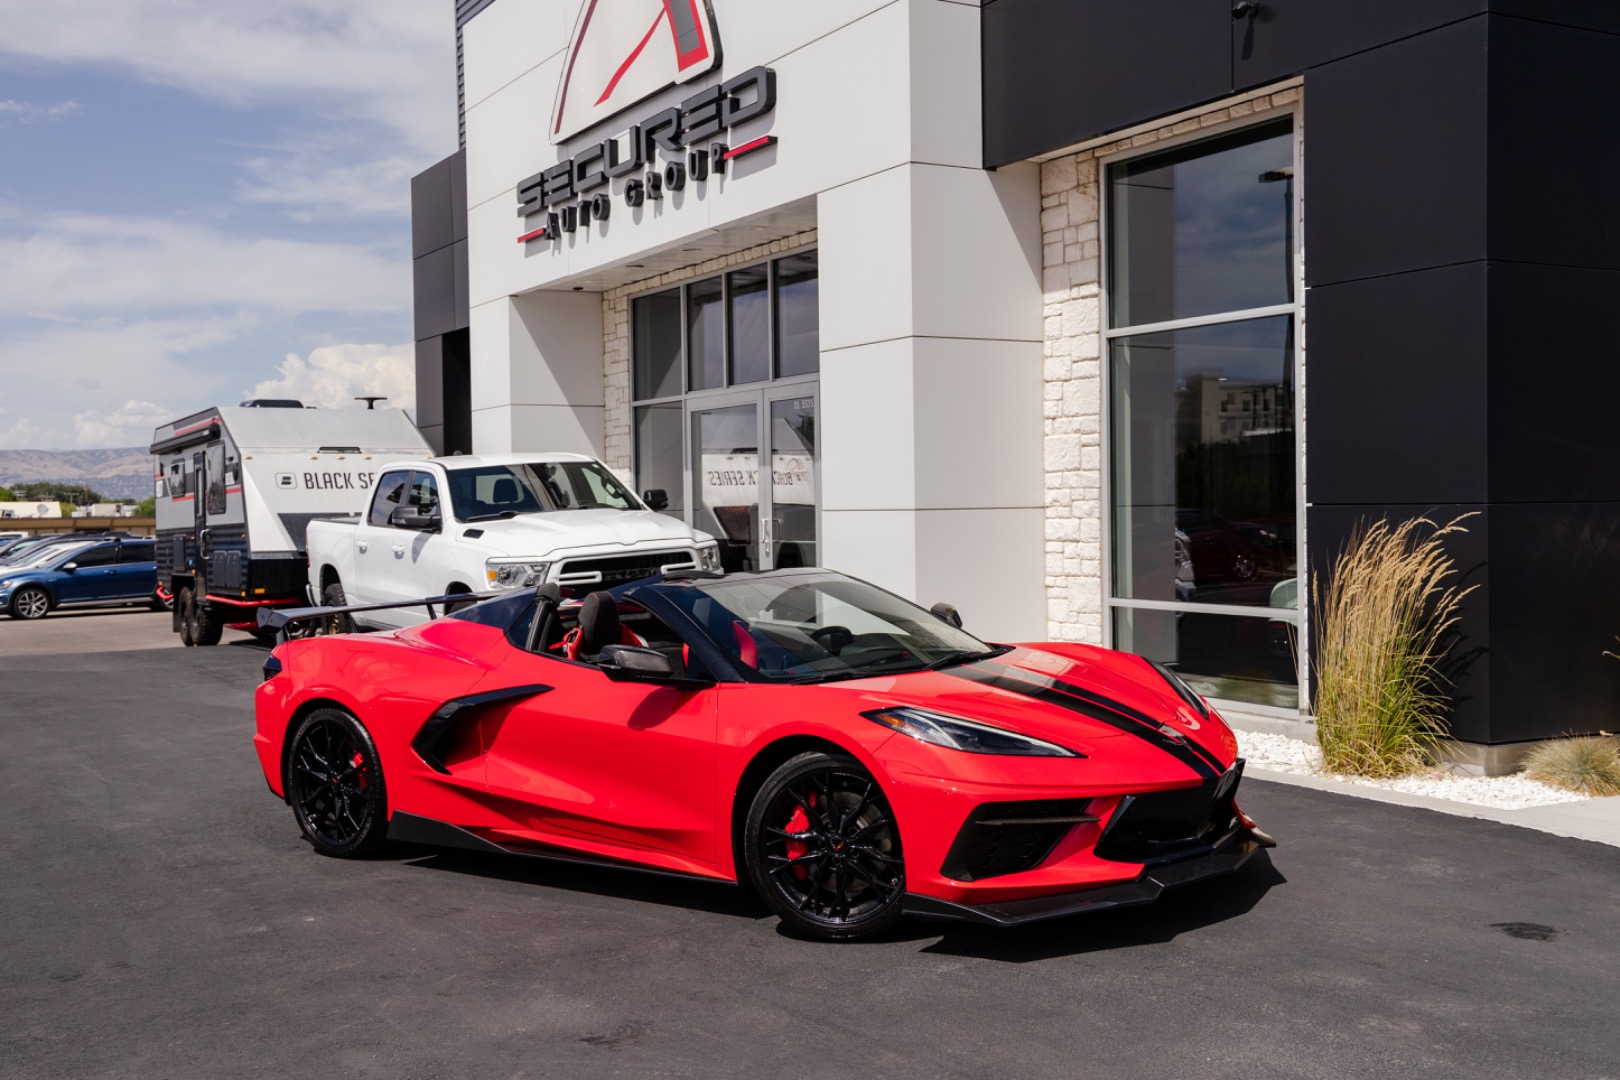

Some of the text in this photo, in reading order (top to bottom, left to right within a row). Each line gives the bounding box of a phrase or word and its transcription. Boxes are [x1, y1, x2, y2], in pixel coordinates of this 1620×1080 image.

[517, 65, 776, 218] SECURED
[545, 142, 730, 240] AUTO GROUP
[303, 472, 354, 489] BLACK
